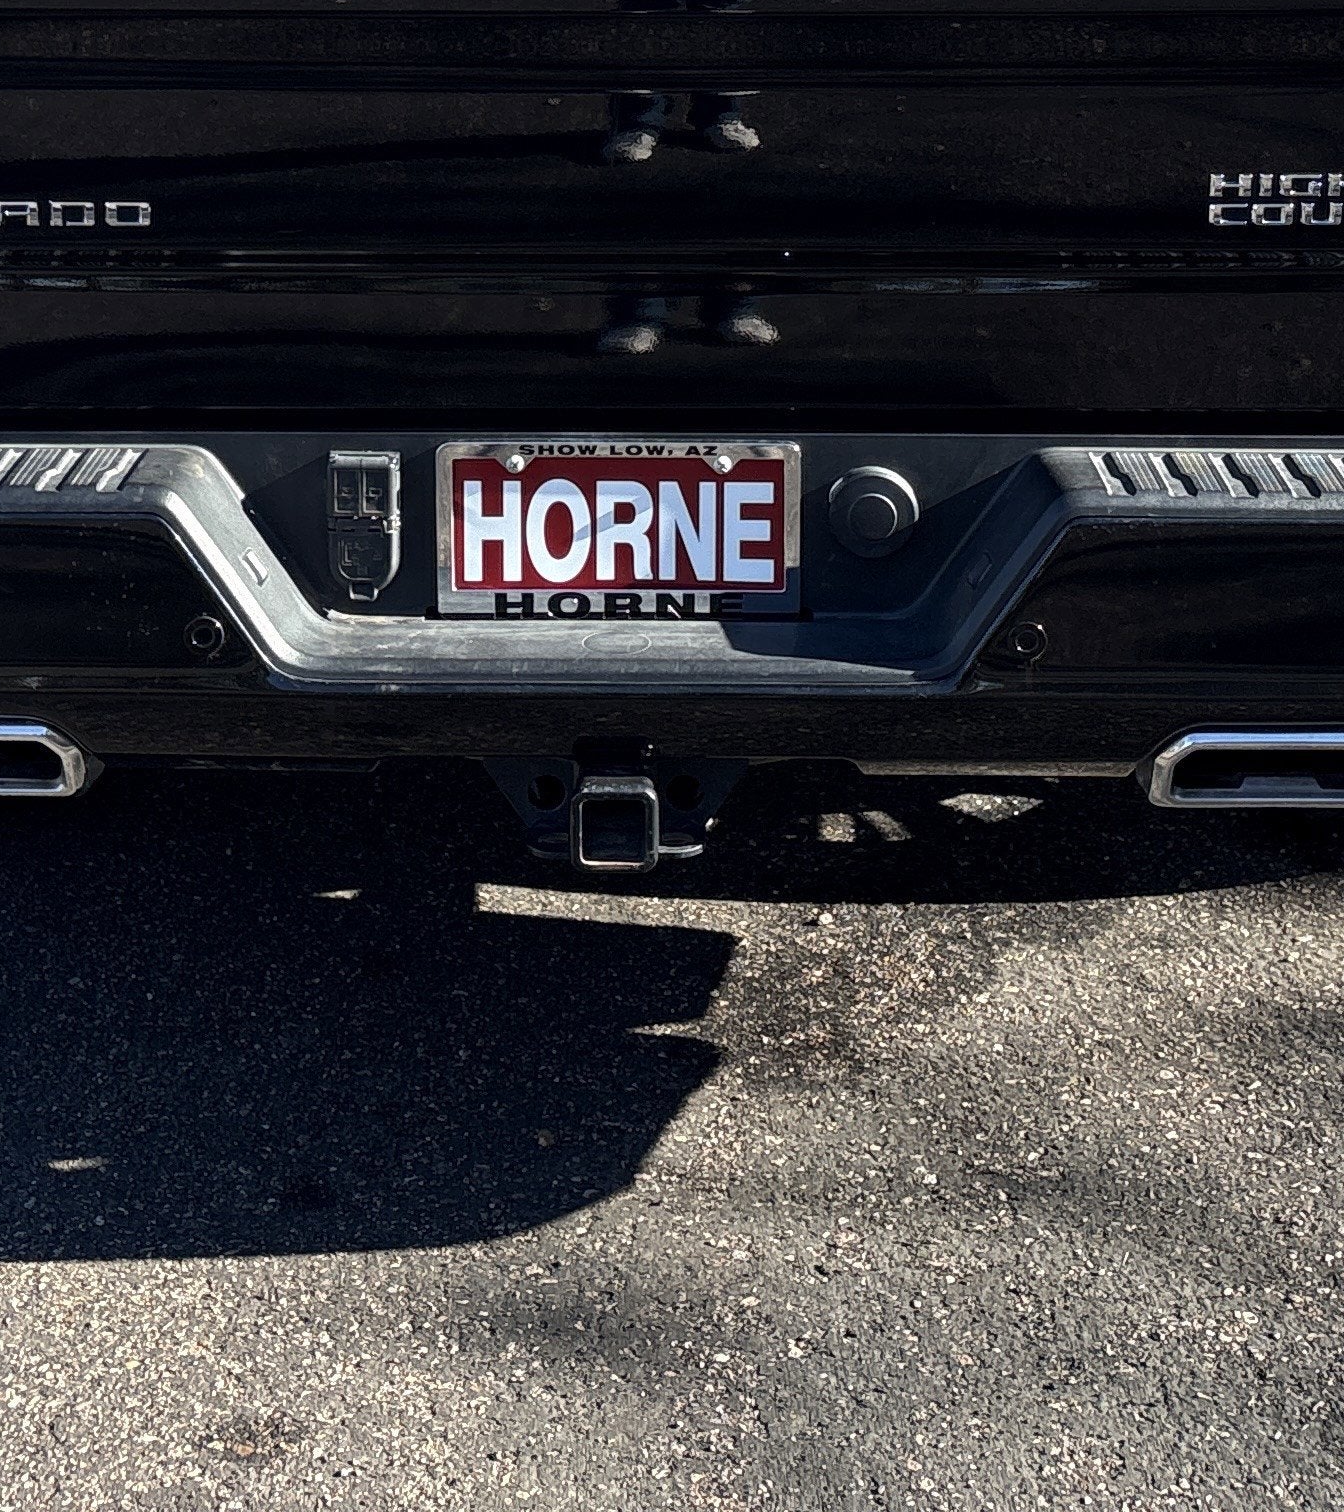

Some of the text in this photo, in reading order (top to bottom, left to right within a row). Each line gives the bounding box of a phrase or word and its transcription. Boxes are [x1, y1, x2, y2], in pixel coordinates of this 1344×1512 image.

[518, 444, 719, 457] SHOW LOW, AZ
[462, 478, 776, 584] HORNE
[494, 592, 744, 620] HORNE
